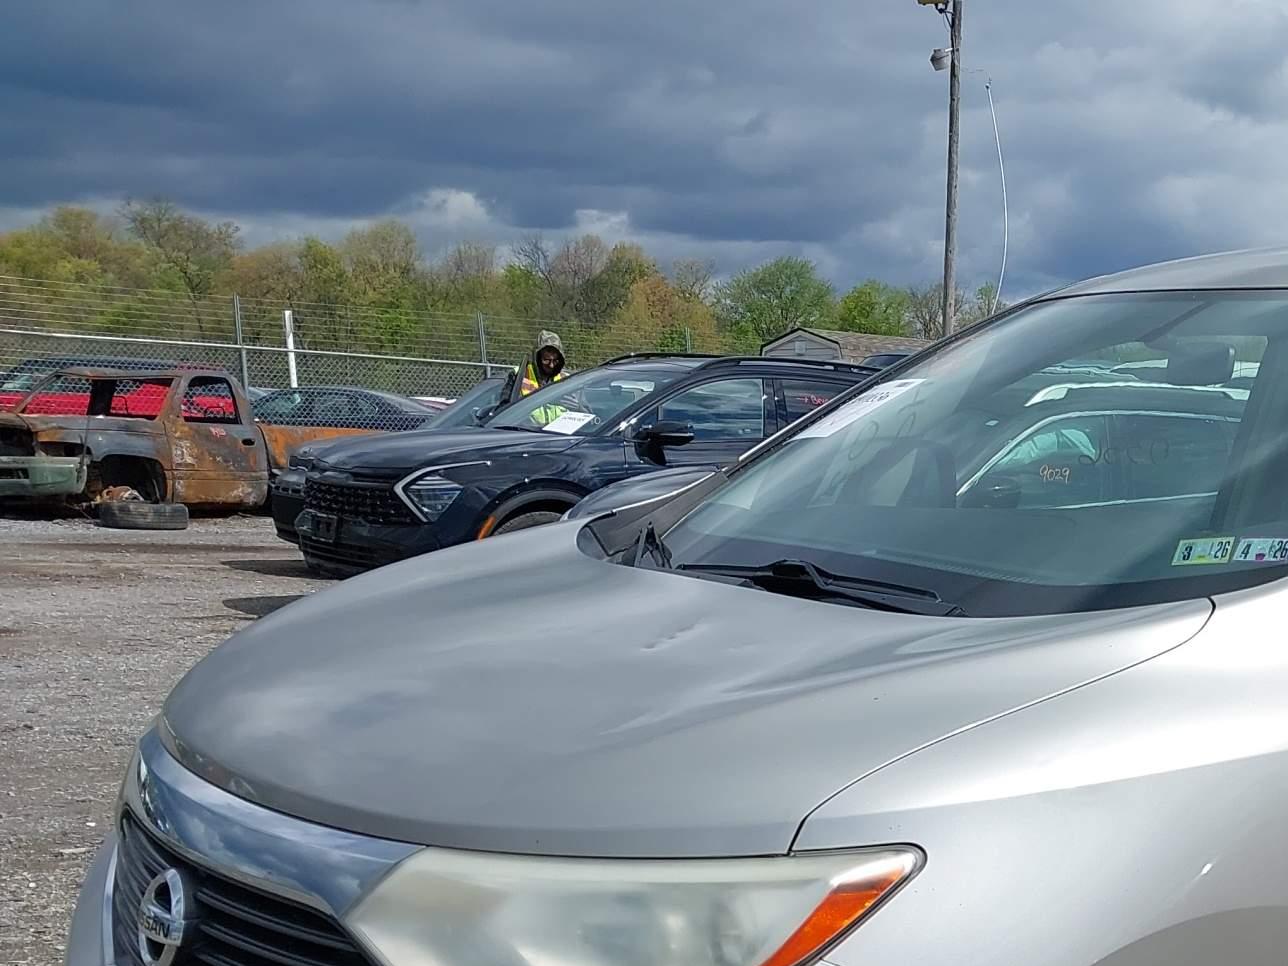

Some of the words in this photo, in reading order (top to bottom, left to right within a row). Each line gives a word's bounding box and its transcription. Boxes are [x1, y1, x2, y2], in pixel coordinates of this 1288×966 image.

[1039, 464, 1071, 484] 9029
[1181, 545, 1193, 561] 3
[1214, 540, 1231, 559] 26
[1240, 543, 1252, 560] 4
